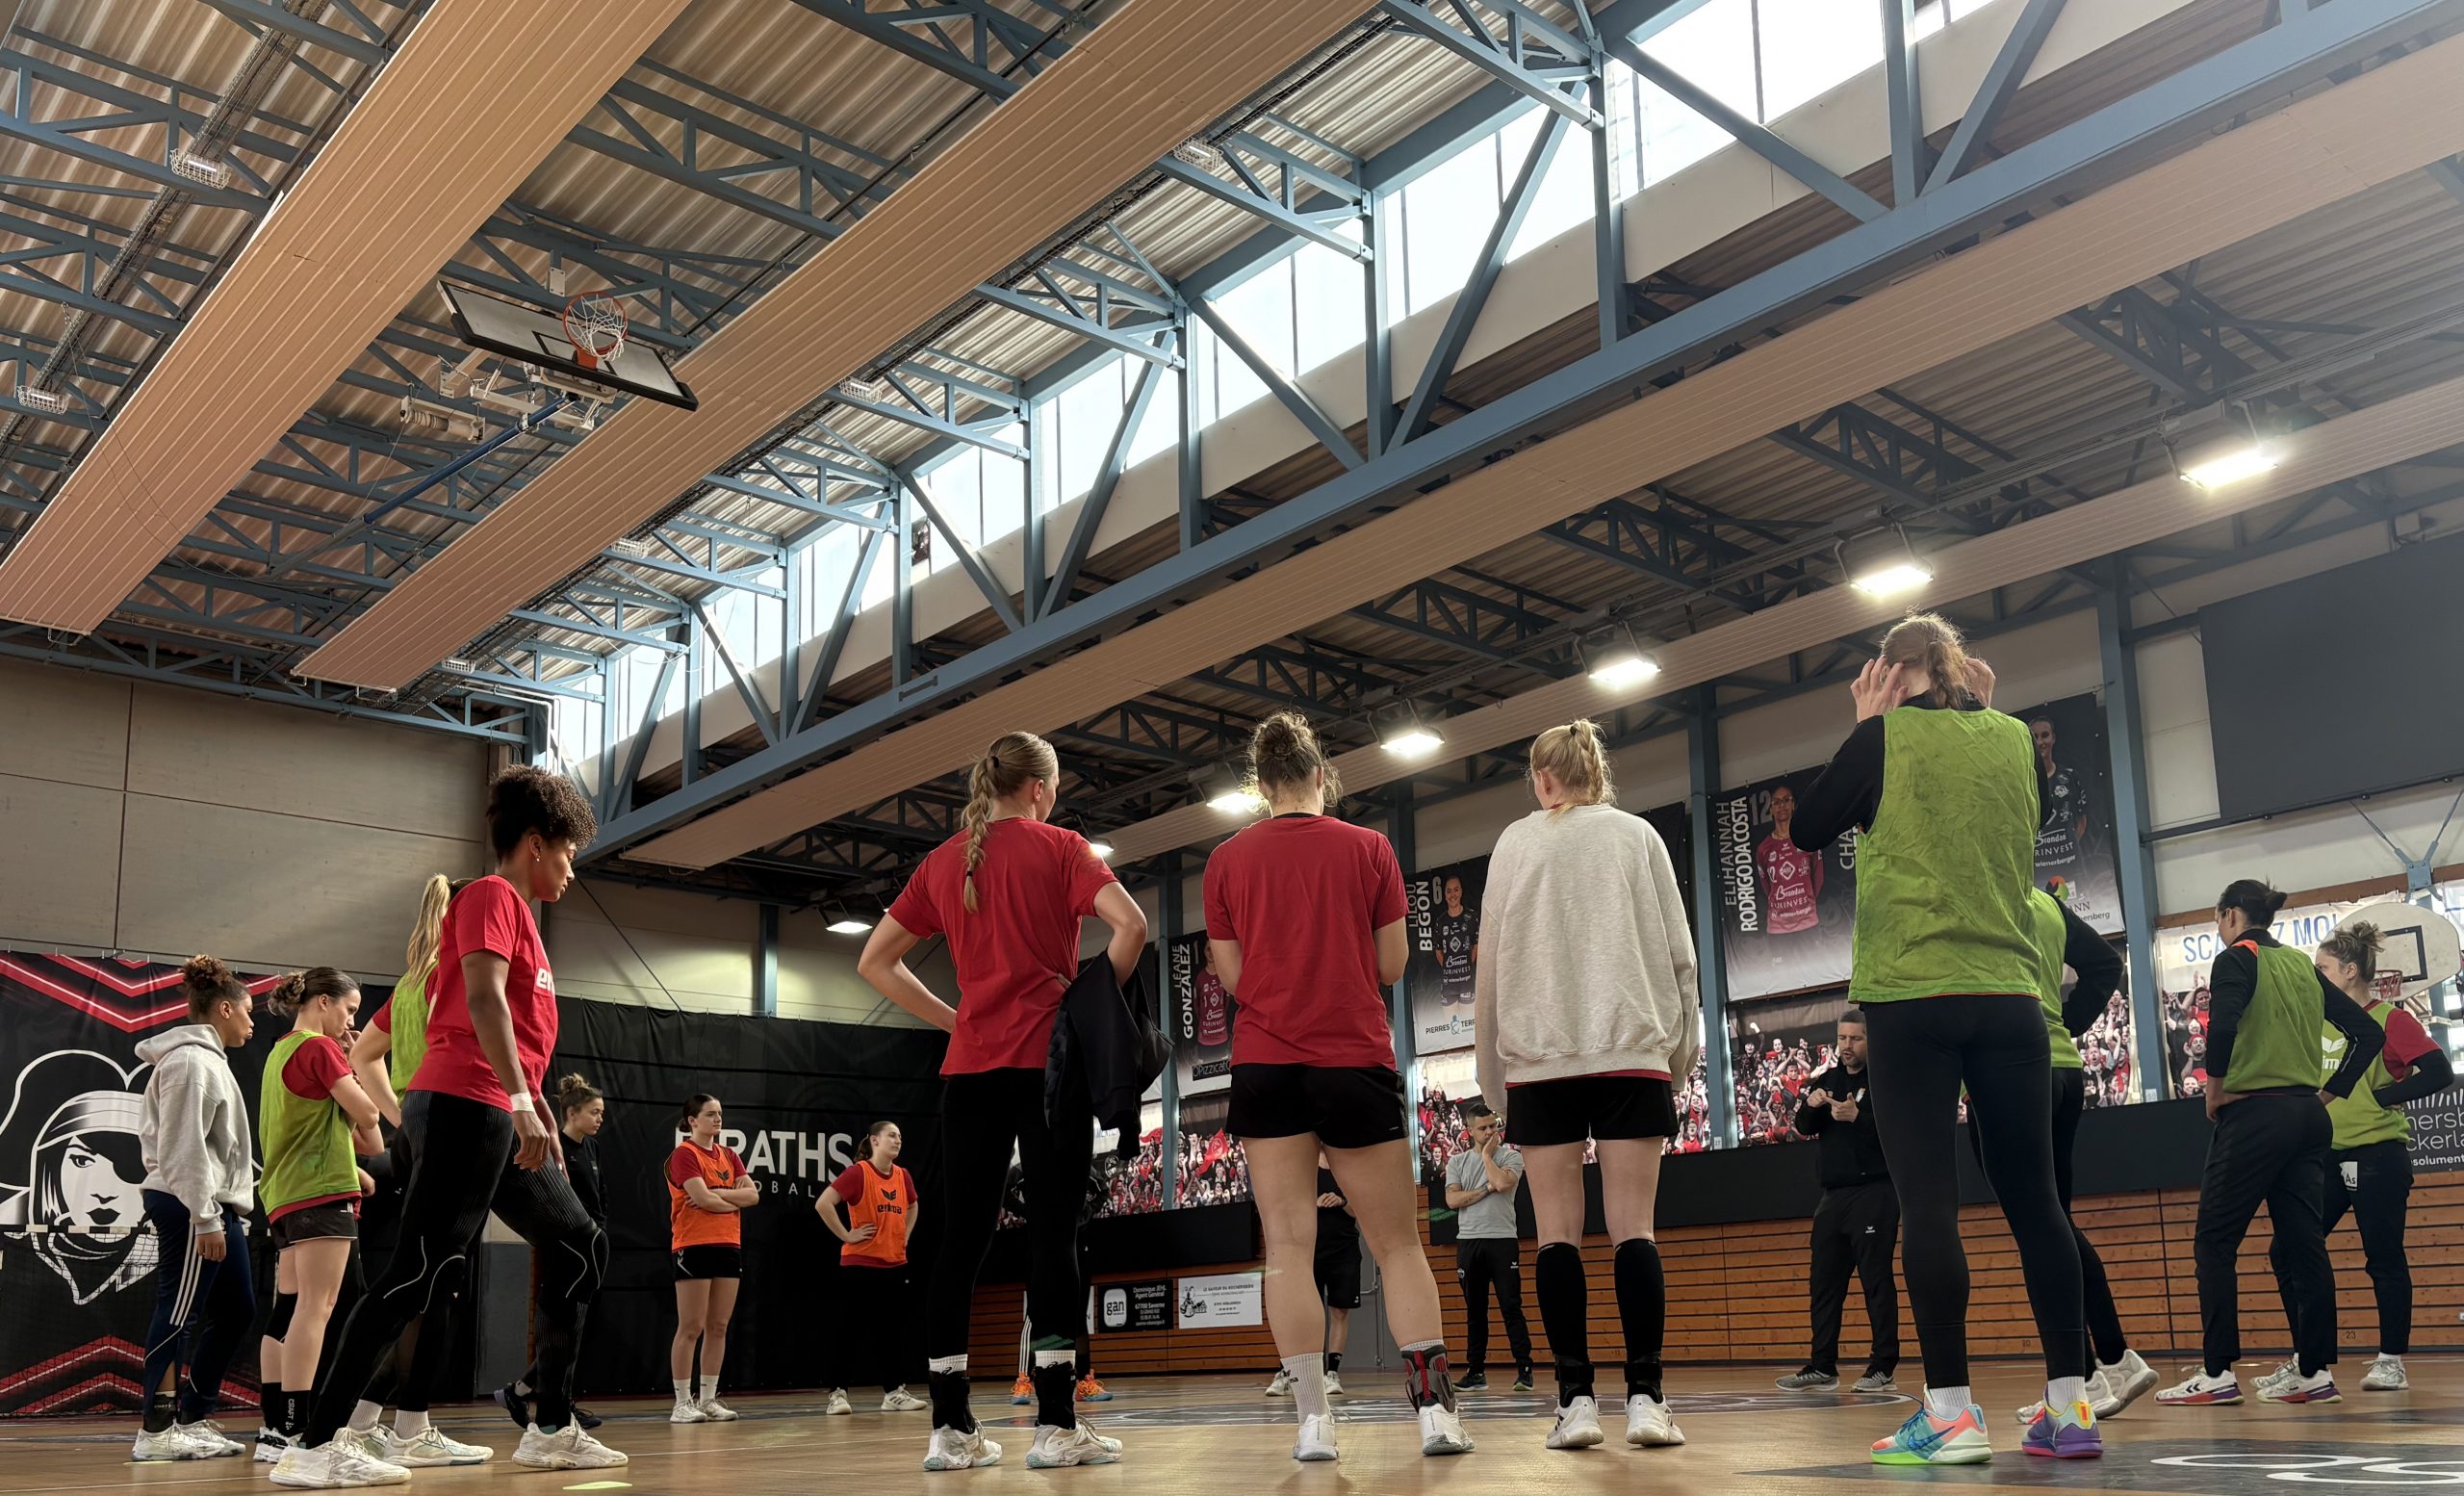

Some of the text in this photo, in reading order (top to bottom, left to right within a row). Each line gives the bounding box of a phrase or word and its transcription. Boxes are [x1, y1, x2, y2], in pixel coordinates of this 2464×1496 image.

[1731, 796, 1750, 842] COSTA
[1749, 789, 1772, 826] 12
[1716, 802, 1736, 906] ELIHANNAH
[1406, 884, 1419, 928] LILOU
[1432, 876, 1442, 905] 6
[1735, 864, 1758, 932] RODRIGO
[1416, 881, 1433, 951] BEGON
[1171, 944, 1183, 989] LÉANE
[1179, 943, 1194, 1040] GONZALEZ
[1425, 1023, 1450, 1035] PIERRES
[676, 1126, 855, 1183] RATHS
[2410, 1154, 2464, 1167] solument
[1106, 1301, 1125, 1316] gan
[2346, 1330, 2356, 1339] 23
